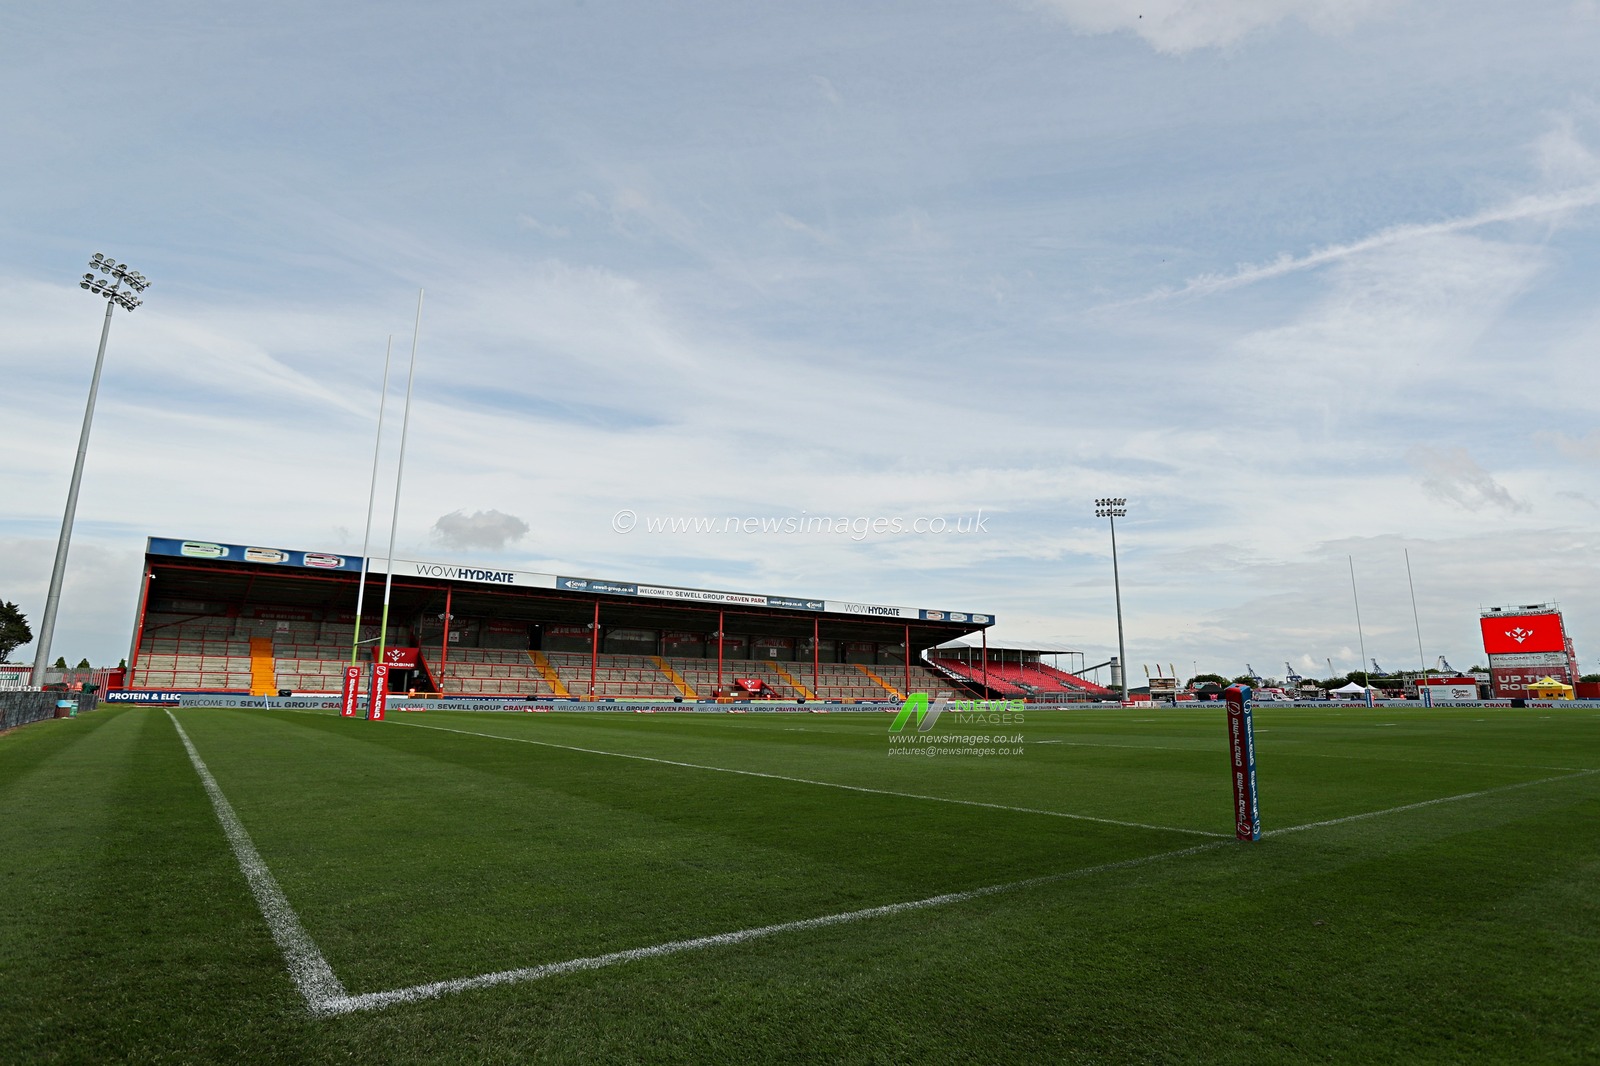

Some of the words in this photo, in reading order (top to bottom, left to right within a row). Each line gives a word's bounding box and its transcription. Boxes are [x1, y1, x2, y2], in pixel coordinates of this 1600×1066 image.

[416, 564, 514, 583] WOWHYDRATE
[571, 580, 588, 588] Sewell
[592, 584, 634, 593] sewell-group.co.uk
[639, 588, 665, 596] WELCOME
[844, 604, 900, 616] WOWHYDRATE
[1498, 675, 1522, 683] UP
[109, 692, 150, 701] PROTEIN
[151, 692, 159, 701] &
[346, 679, 356, 715] BETFRED
[373, 677, 384, 719] BETFRED
[240, 700, 282, 708] SEWELL
[284, 701, 318, 709] GROUP
[1232, 717, 1243, 767] BETFRED
